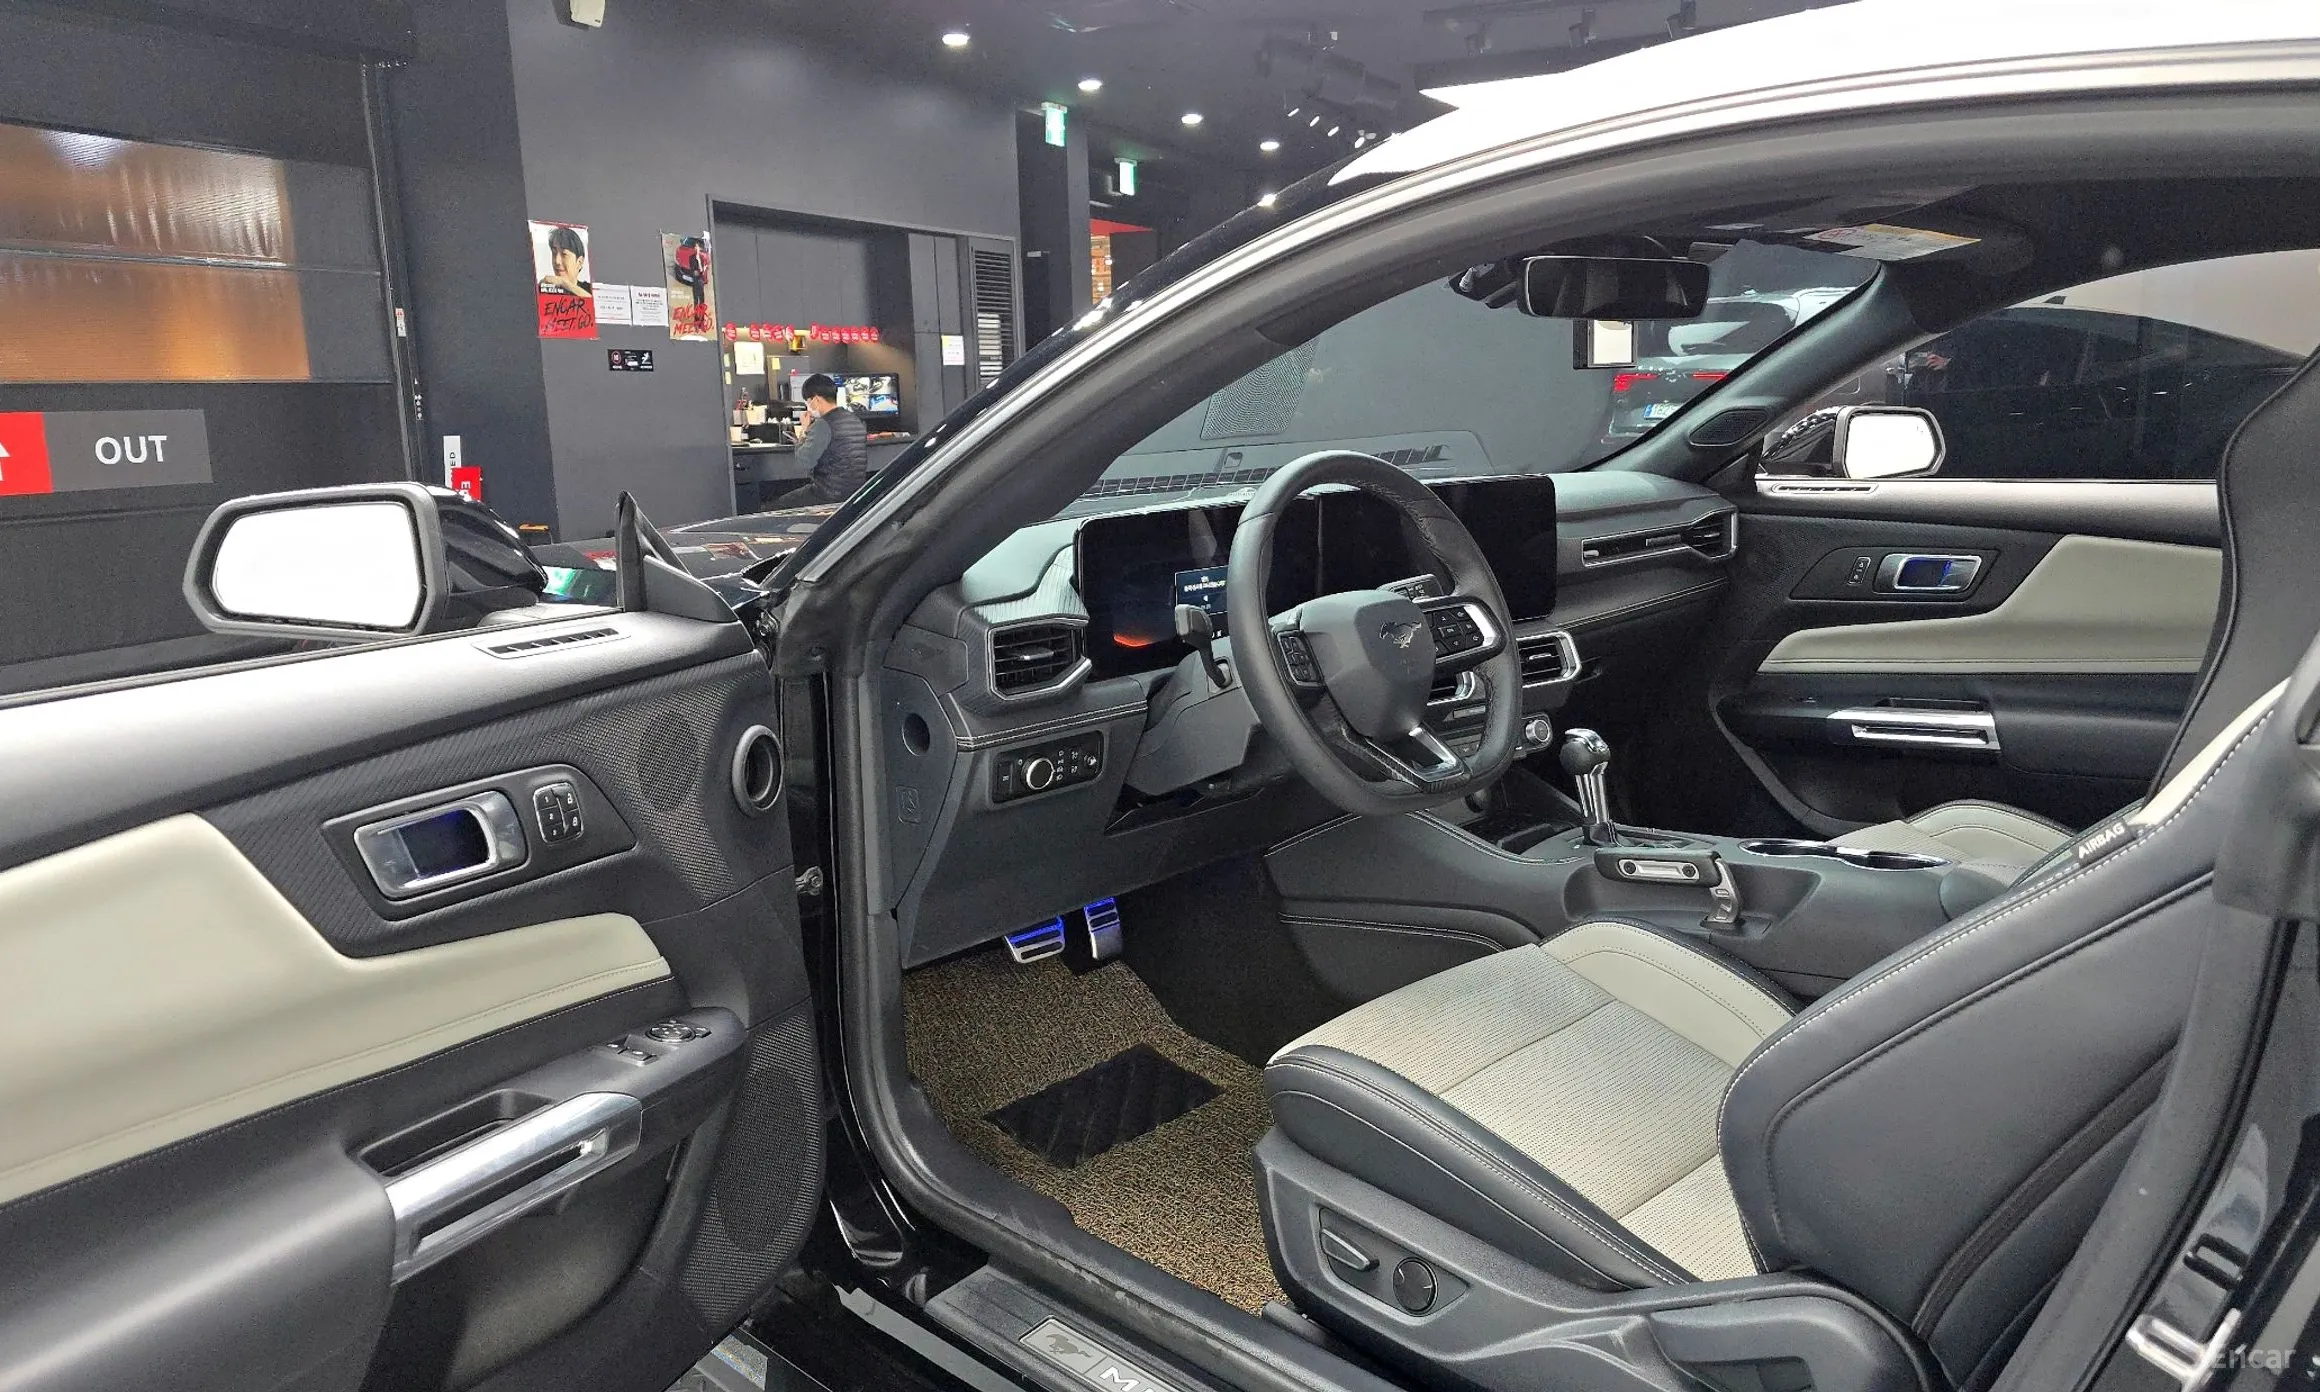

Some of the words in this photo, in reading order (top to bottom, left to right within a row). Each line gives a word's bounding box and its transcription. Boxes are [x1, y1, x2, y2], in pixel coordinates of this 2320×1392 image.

[95, 435, 168, 465] OUT
[2078, 821, 2126, 859] AIRBAG
[1099, 1366, 1154, 1392] M
